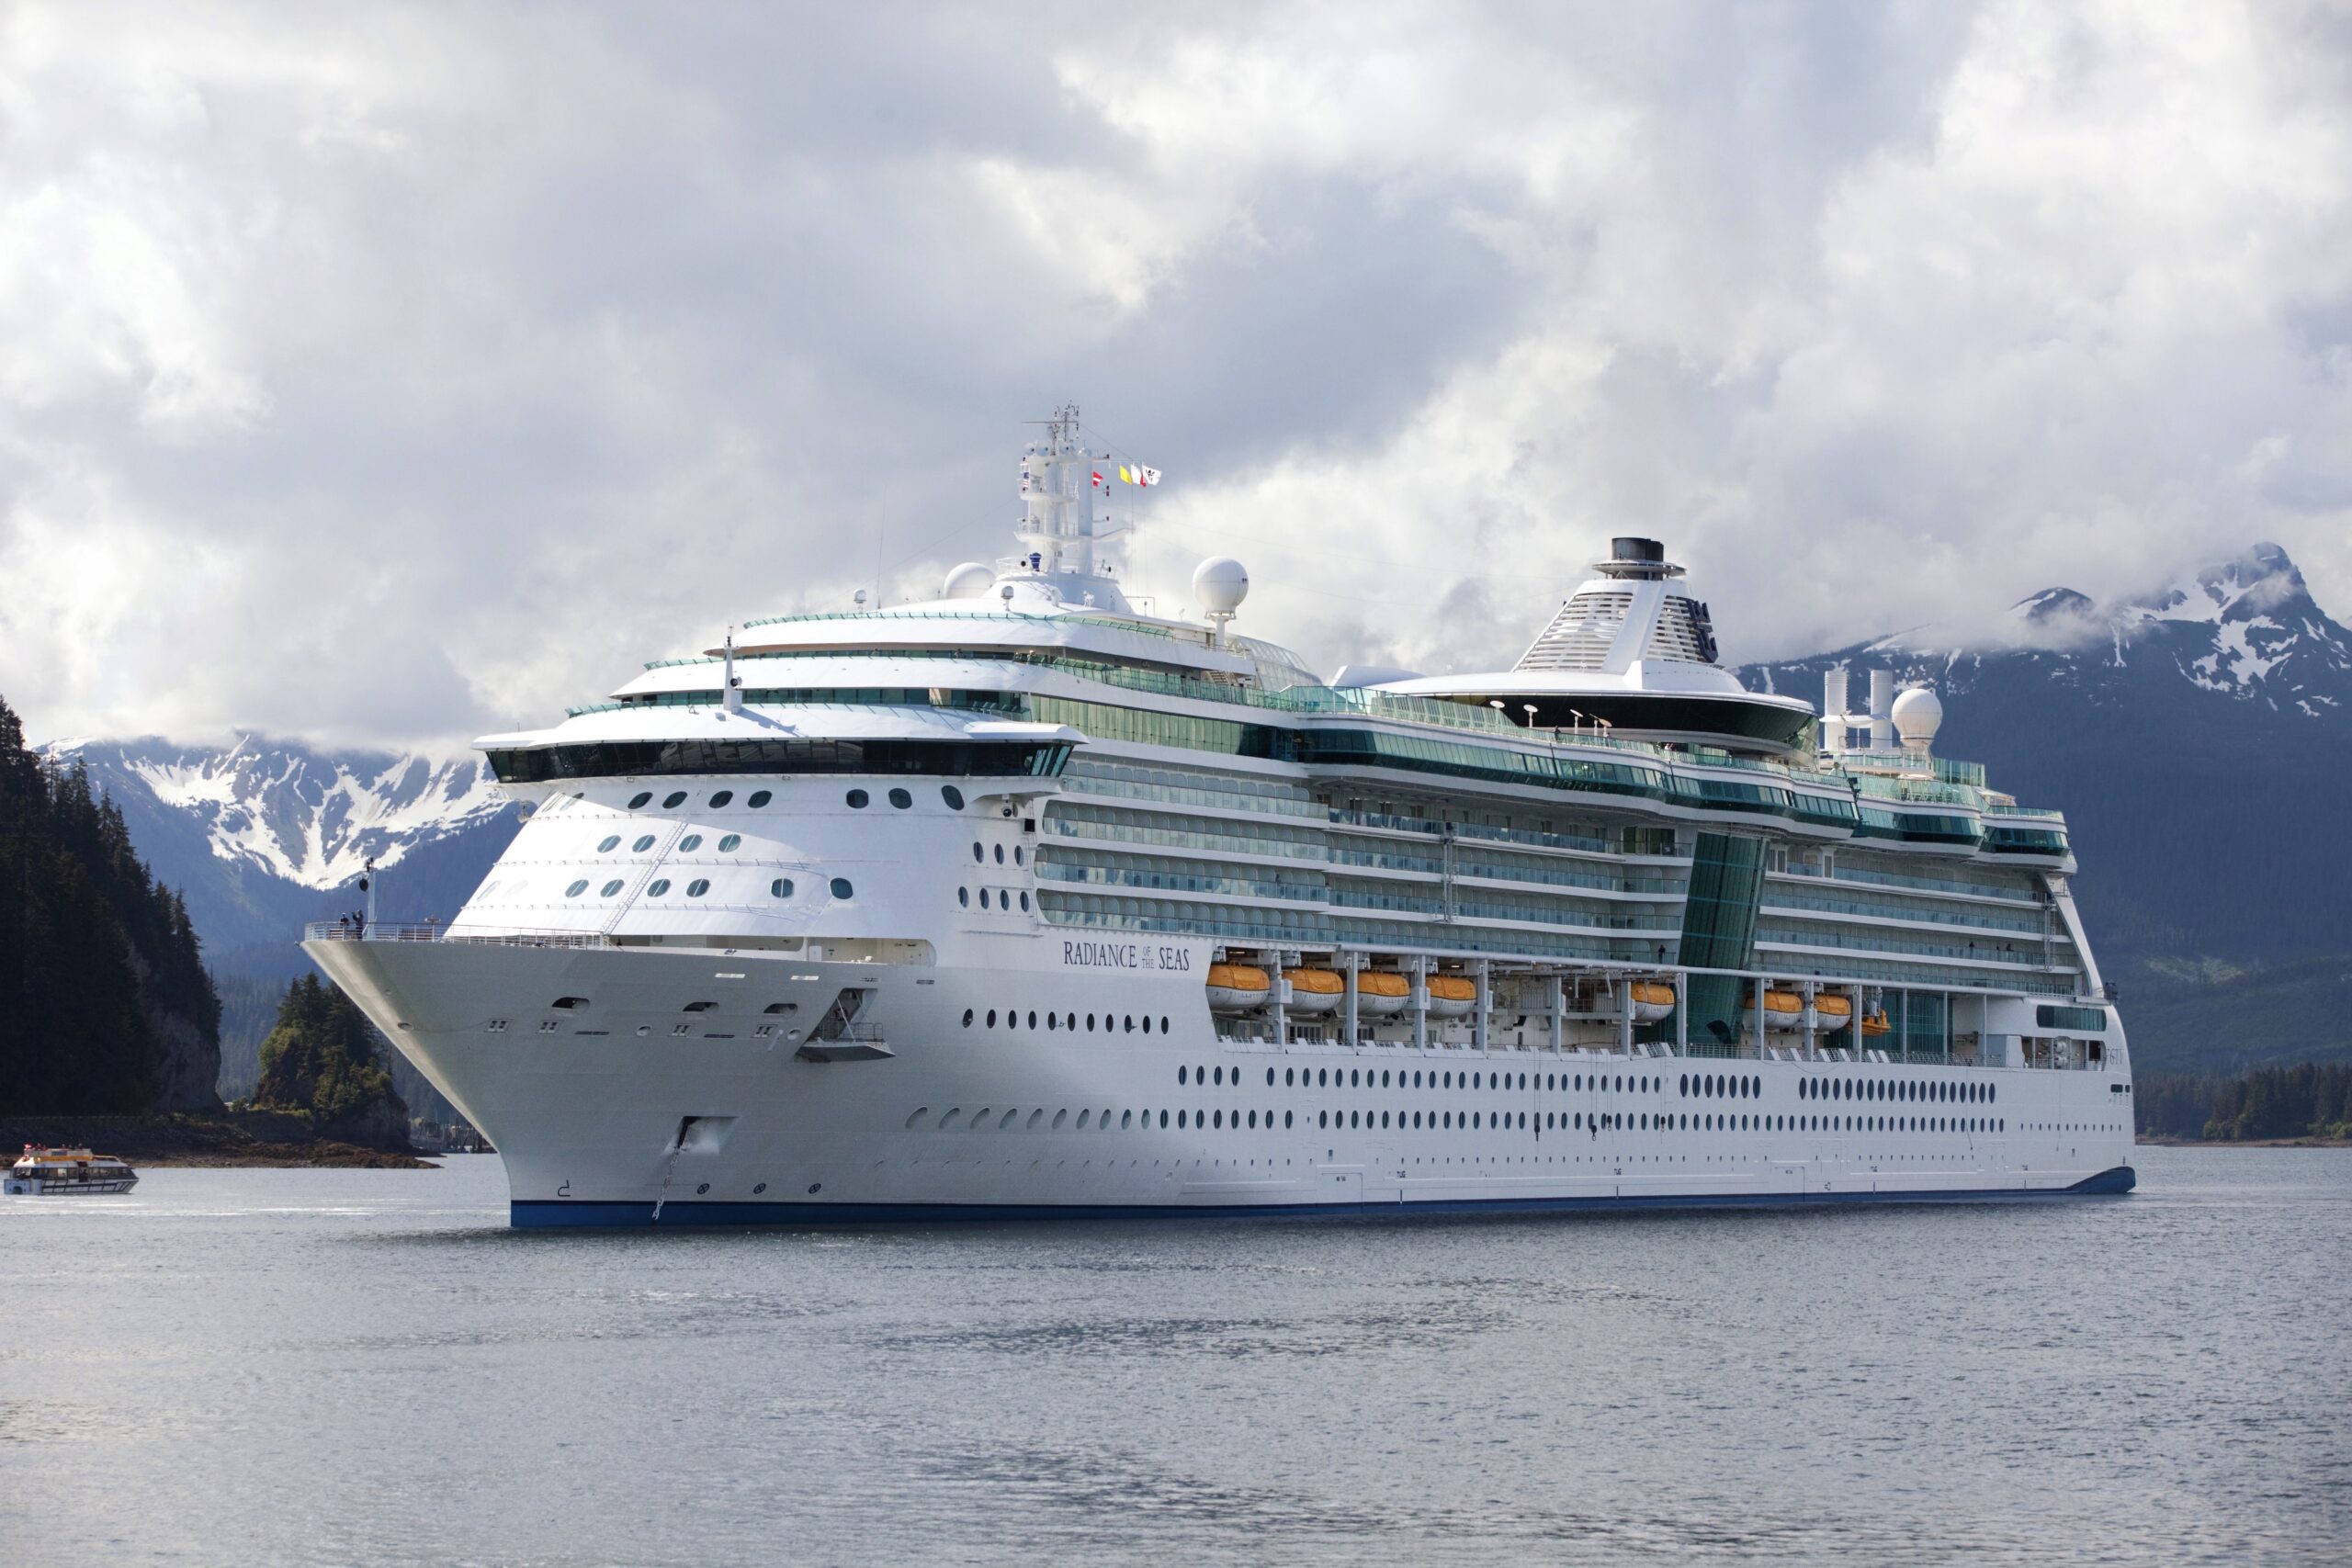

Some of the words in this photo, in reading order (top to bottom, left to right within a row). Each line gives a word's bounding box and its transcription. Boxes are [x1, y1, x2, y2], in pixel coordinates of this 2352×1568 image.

[1064, 942, 1137, 968] RADIANCE
[1143, 946, 1151, 956] OF
[1159, 947, 1190, 972] SEAS
[1142, 958, 1155, 969] THE
